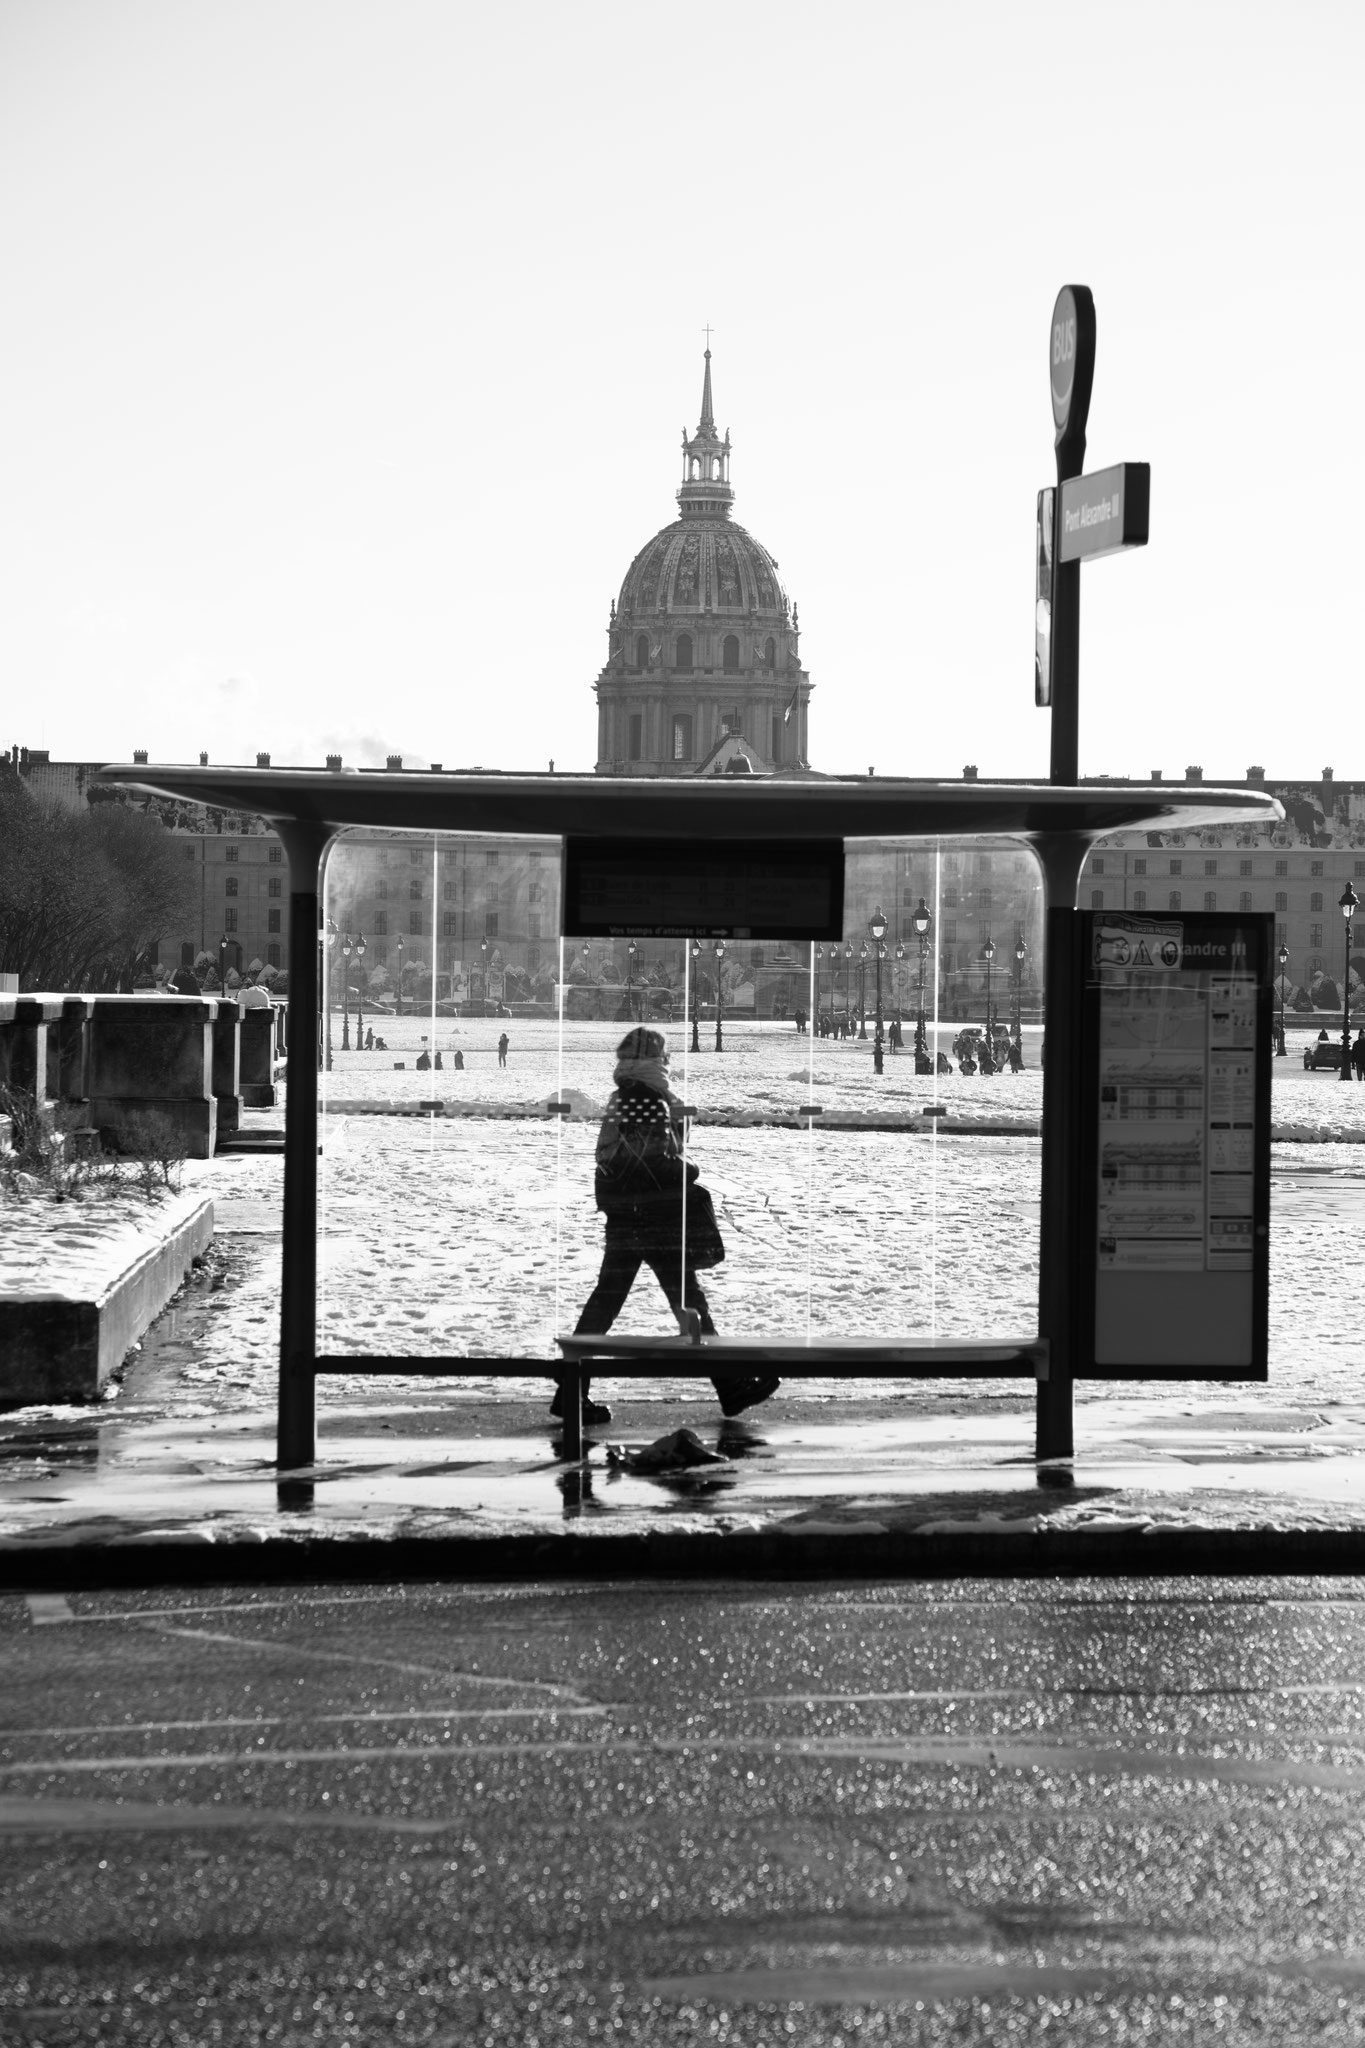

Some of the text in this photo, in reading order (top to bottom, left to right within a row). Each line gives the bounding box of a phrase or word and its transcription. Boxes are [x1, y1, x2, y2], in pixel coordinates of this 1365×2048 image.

[1054, 318, 1074, 365] BUS
[1065, 502, 1080, 533] Pont
[1080, 496, 1111, 528] Alexandre
[609, 926, 706, 936] Vos temps d'attente ici
[1231, 942, 1246, 956] III
